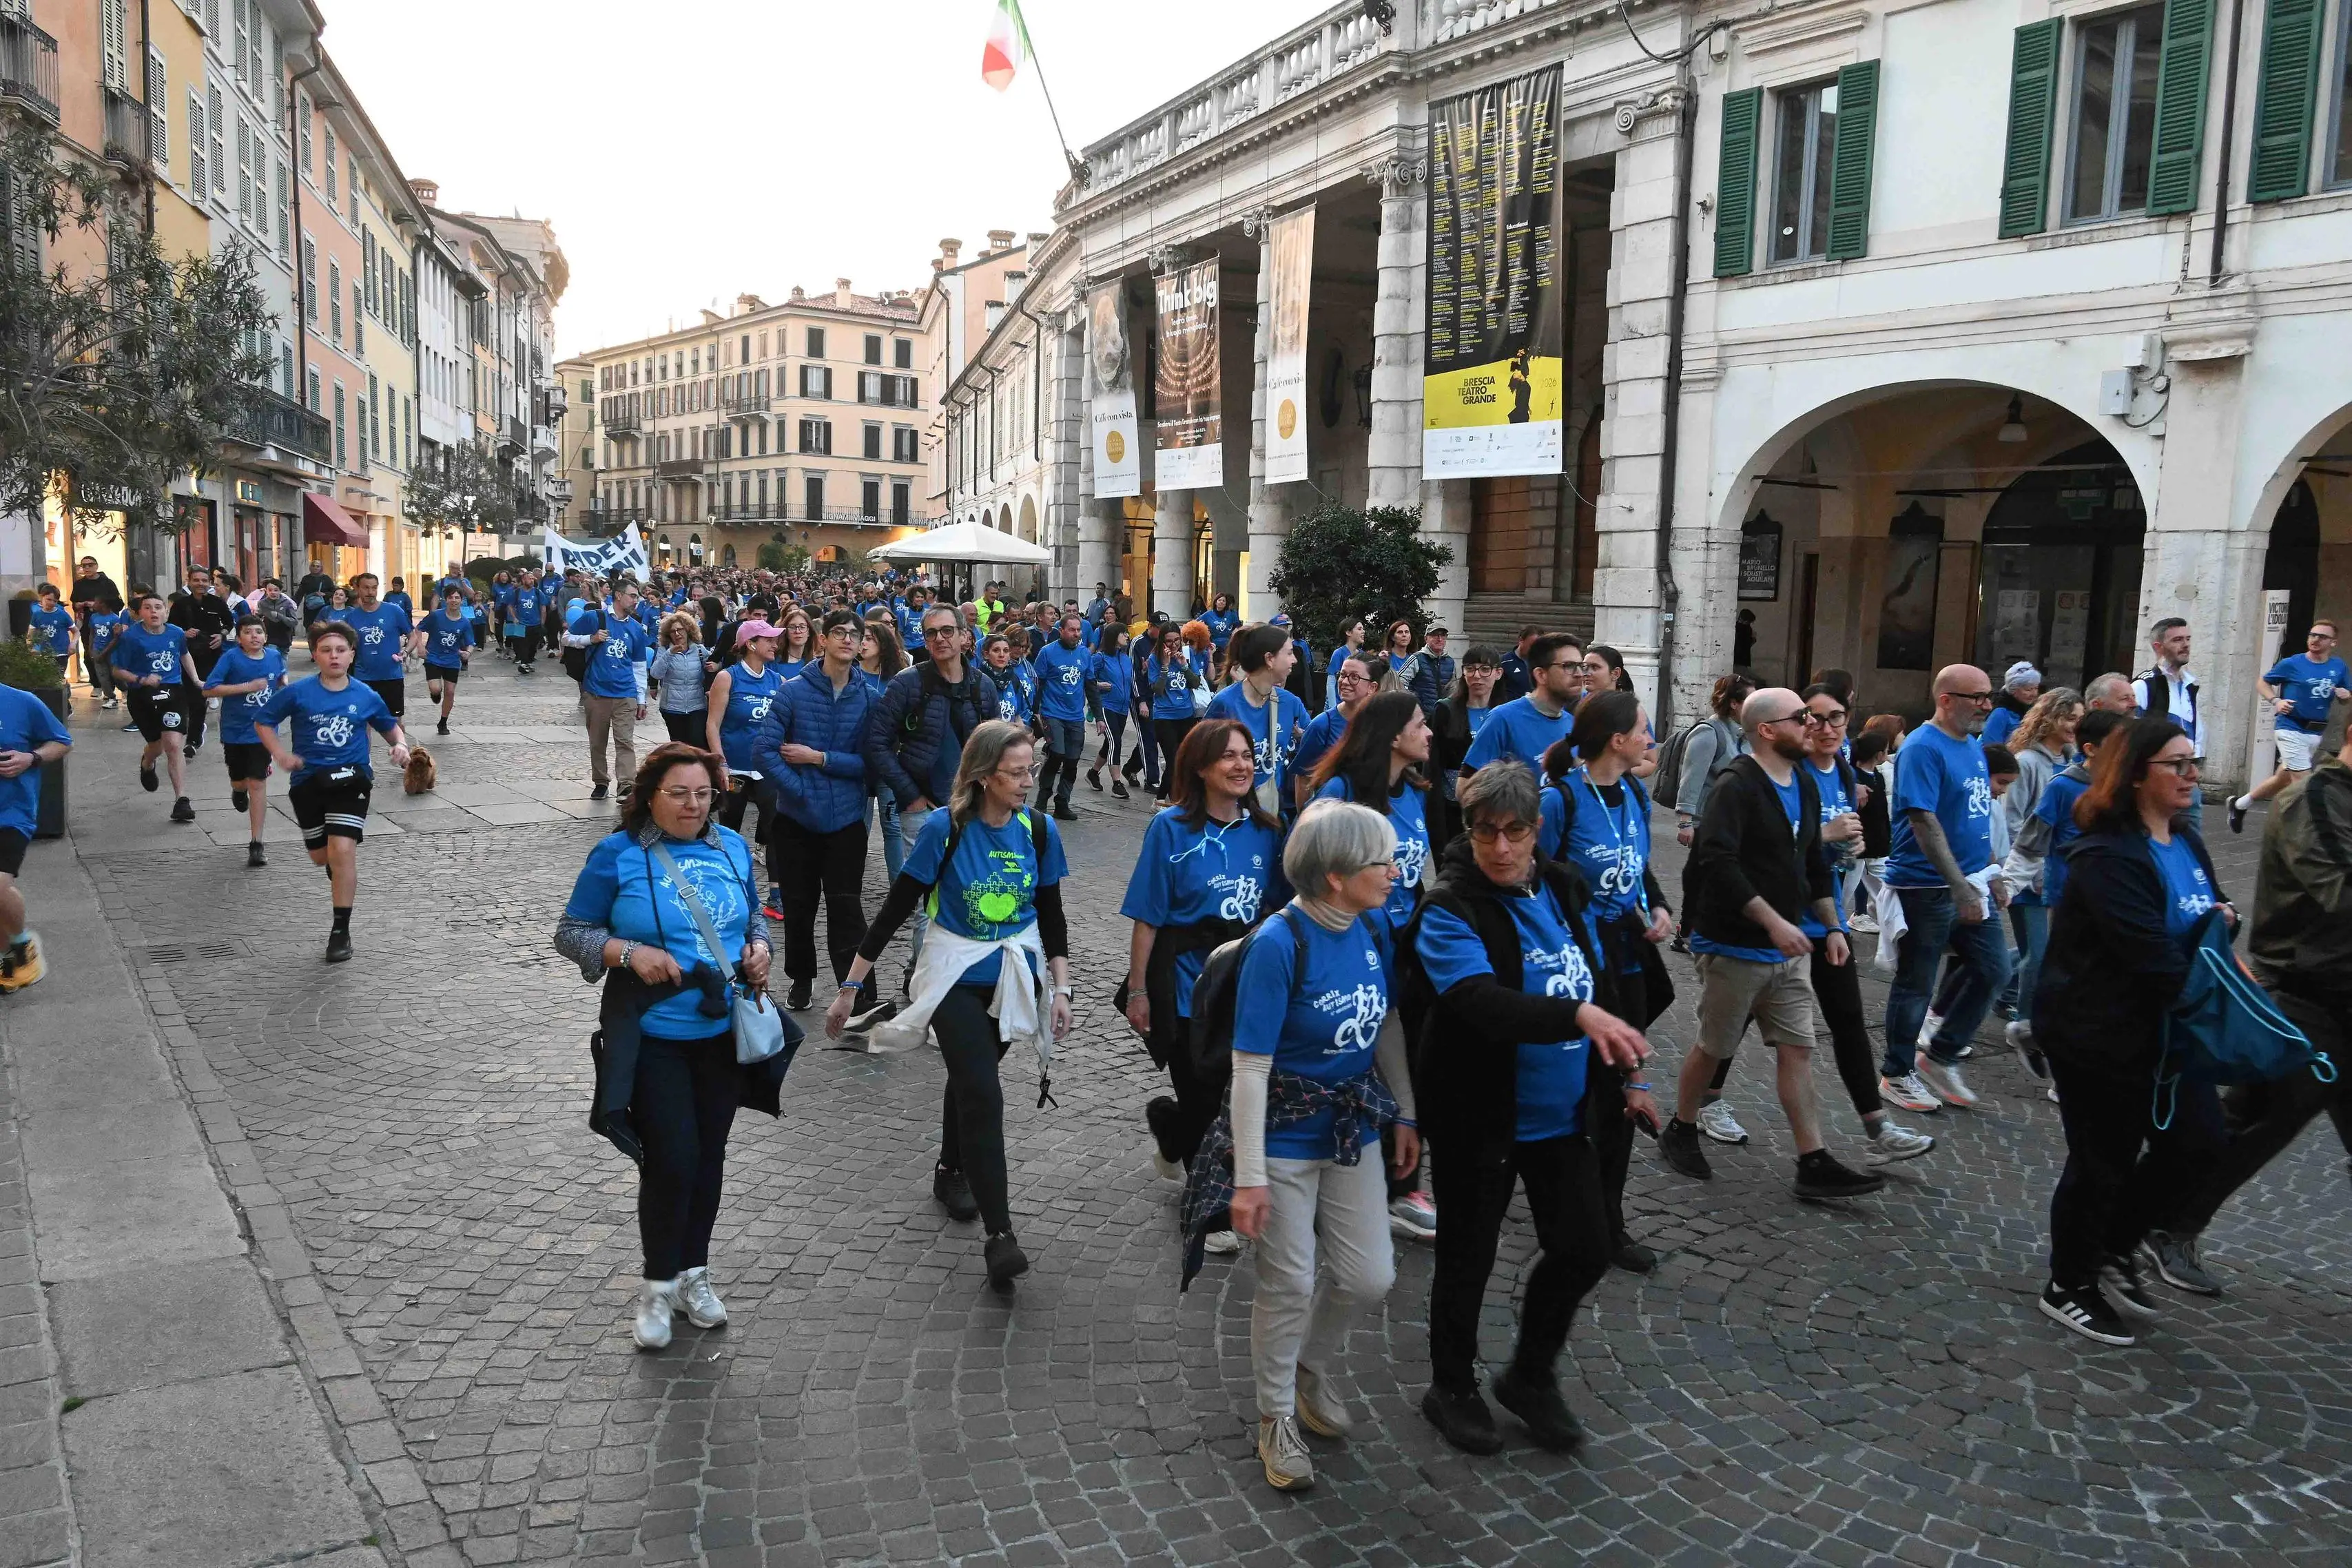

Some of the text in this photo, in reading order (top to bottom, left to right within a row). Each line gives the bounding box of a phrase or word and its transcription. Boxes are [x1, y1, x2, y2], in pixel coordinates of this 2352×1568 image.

[1506, 220, 1528, 230] Educational
[1157, 277, 1217, 314] Think big
[1463, 376, 1495, 386] BRESCIA
[1457, 386, 1487, 396] TEATRO
[1463, 394, 1496, 405] GRANDE
[1107, 413, 1117, 422] con
[1119, 410, 1134, 419] vista.
[561, 531, 630, 568] RIDER
[989, 850, 1014, 858] AUTISM
